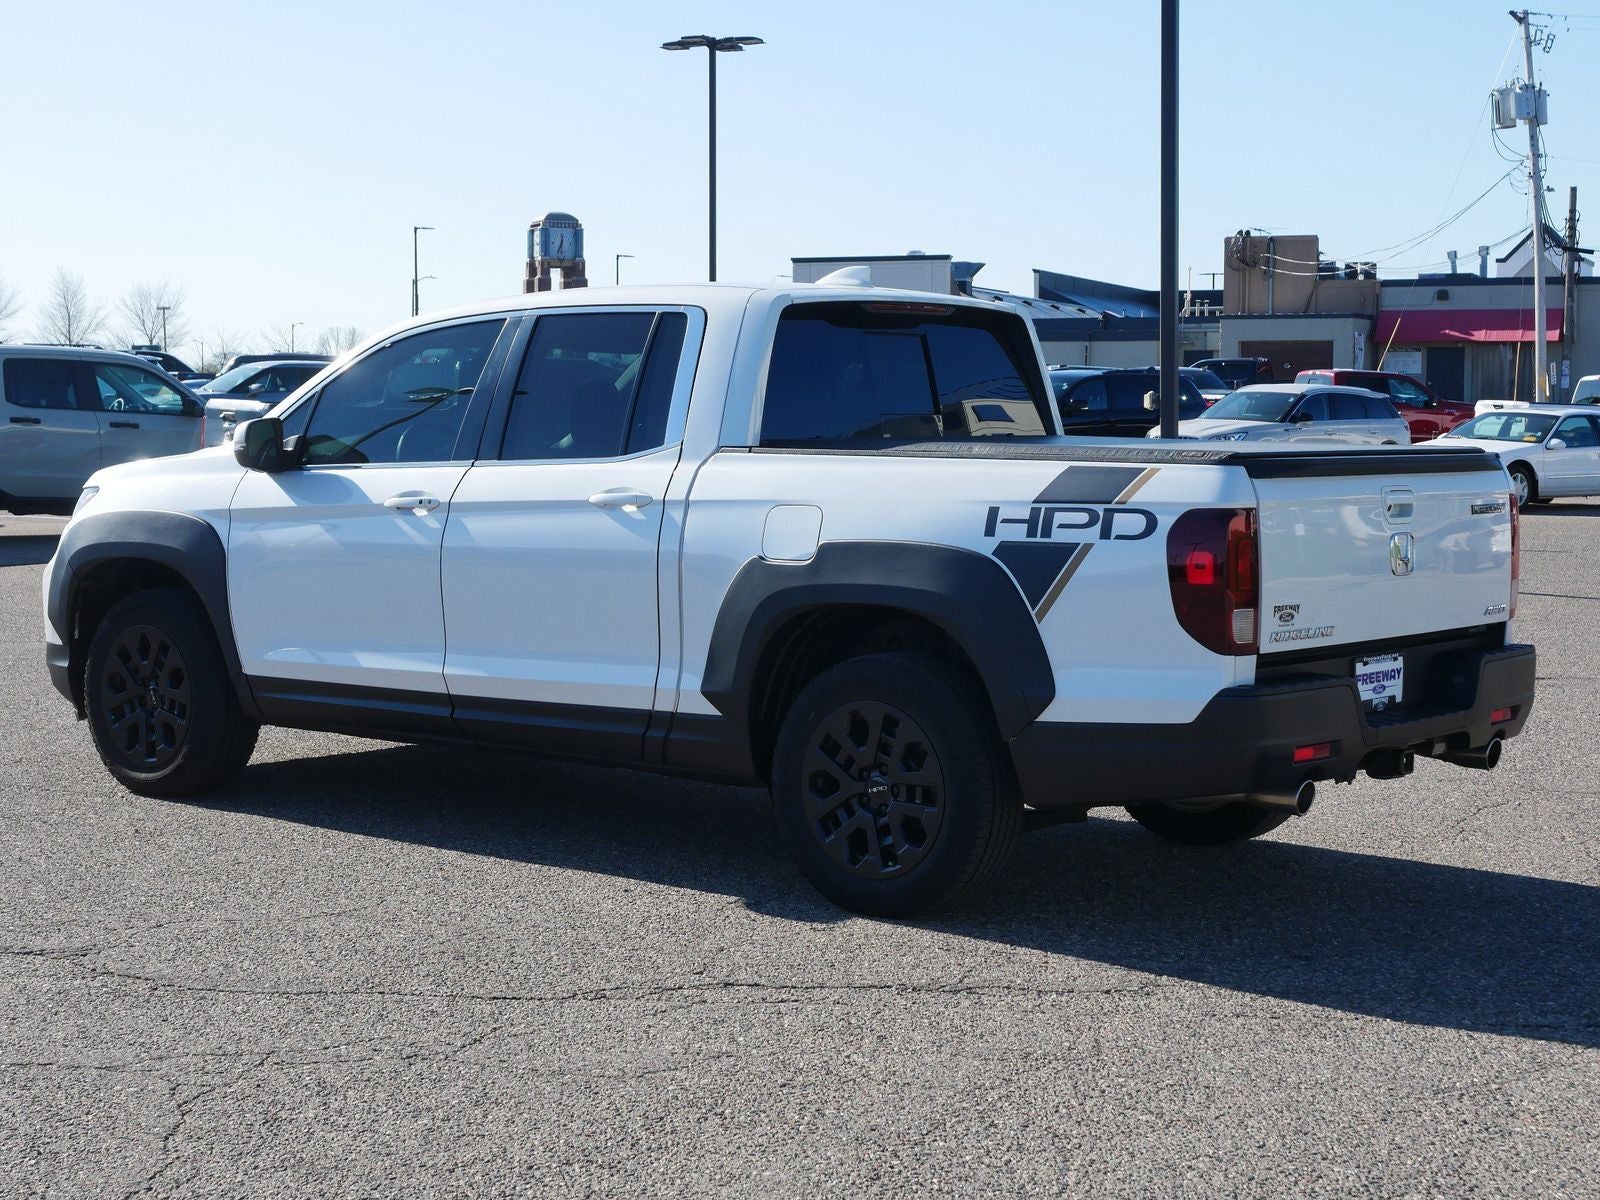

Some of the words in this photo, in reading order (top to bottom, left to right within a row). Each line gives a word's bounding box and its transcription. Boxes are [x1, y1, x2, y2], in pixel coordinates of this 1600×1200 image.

[983, 506, 1158, 541] HPD
[1273, 604, 1301, 618] FREEWAY
[1269, 626, 1335, 644] RIDGELINE
[1355, 667, 1402, 686] FREEWAY
